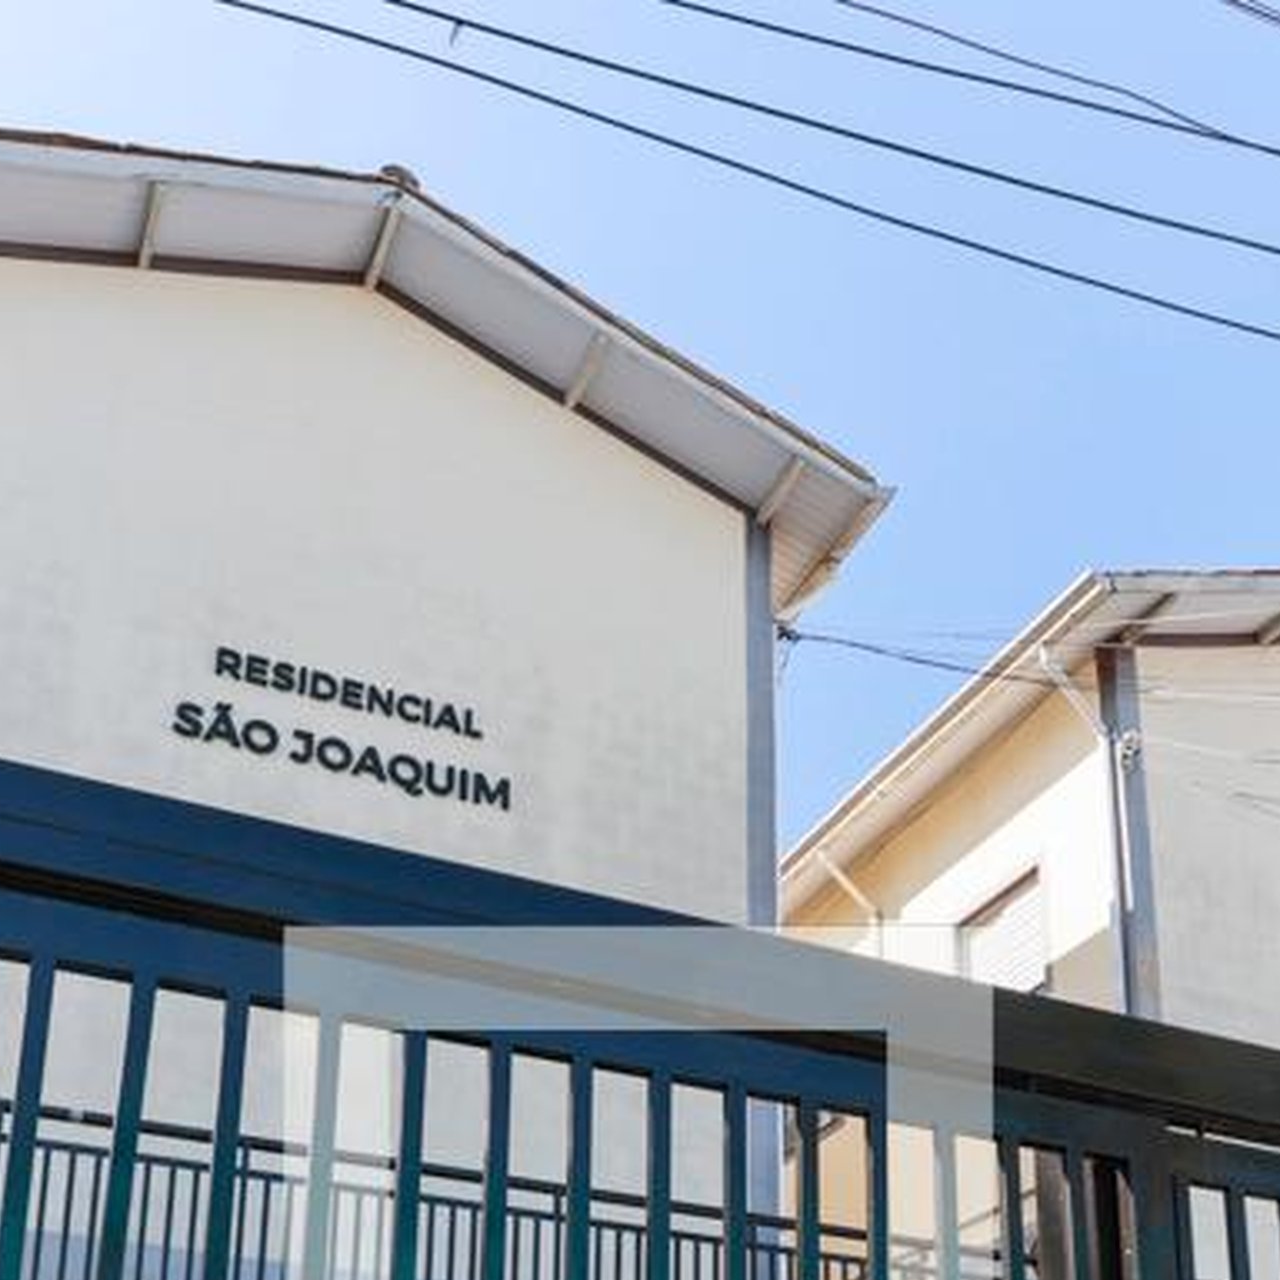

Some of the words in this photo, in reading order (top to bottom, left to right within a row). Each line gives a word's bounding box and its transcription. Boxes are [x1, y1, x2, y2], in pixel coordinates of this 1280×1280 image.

[215, 647, 483, 738] RESIDENCIAL
[172, 701, 279, 755] SÃO
[289, 730, 511, 811] JOAQUIM
